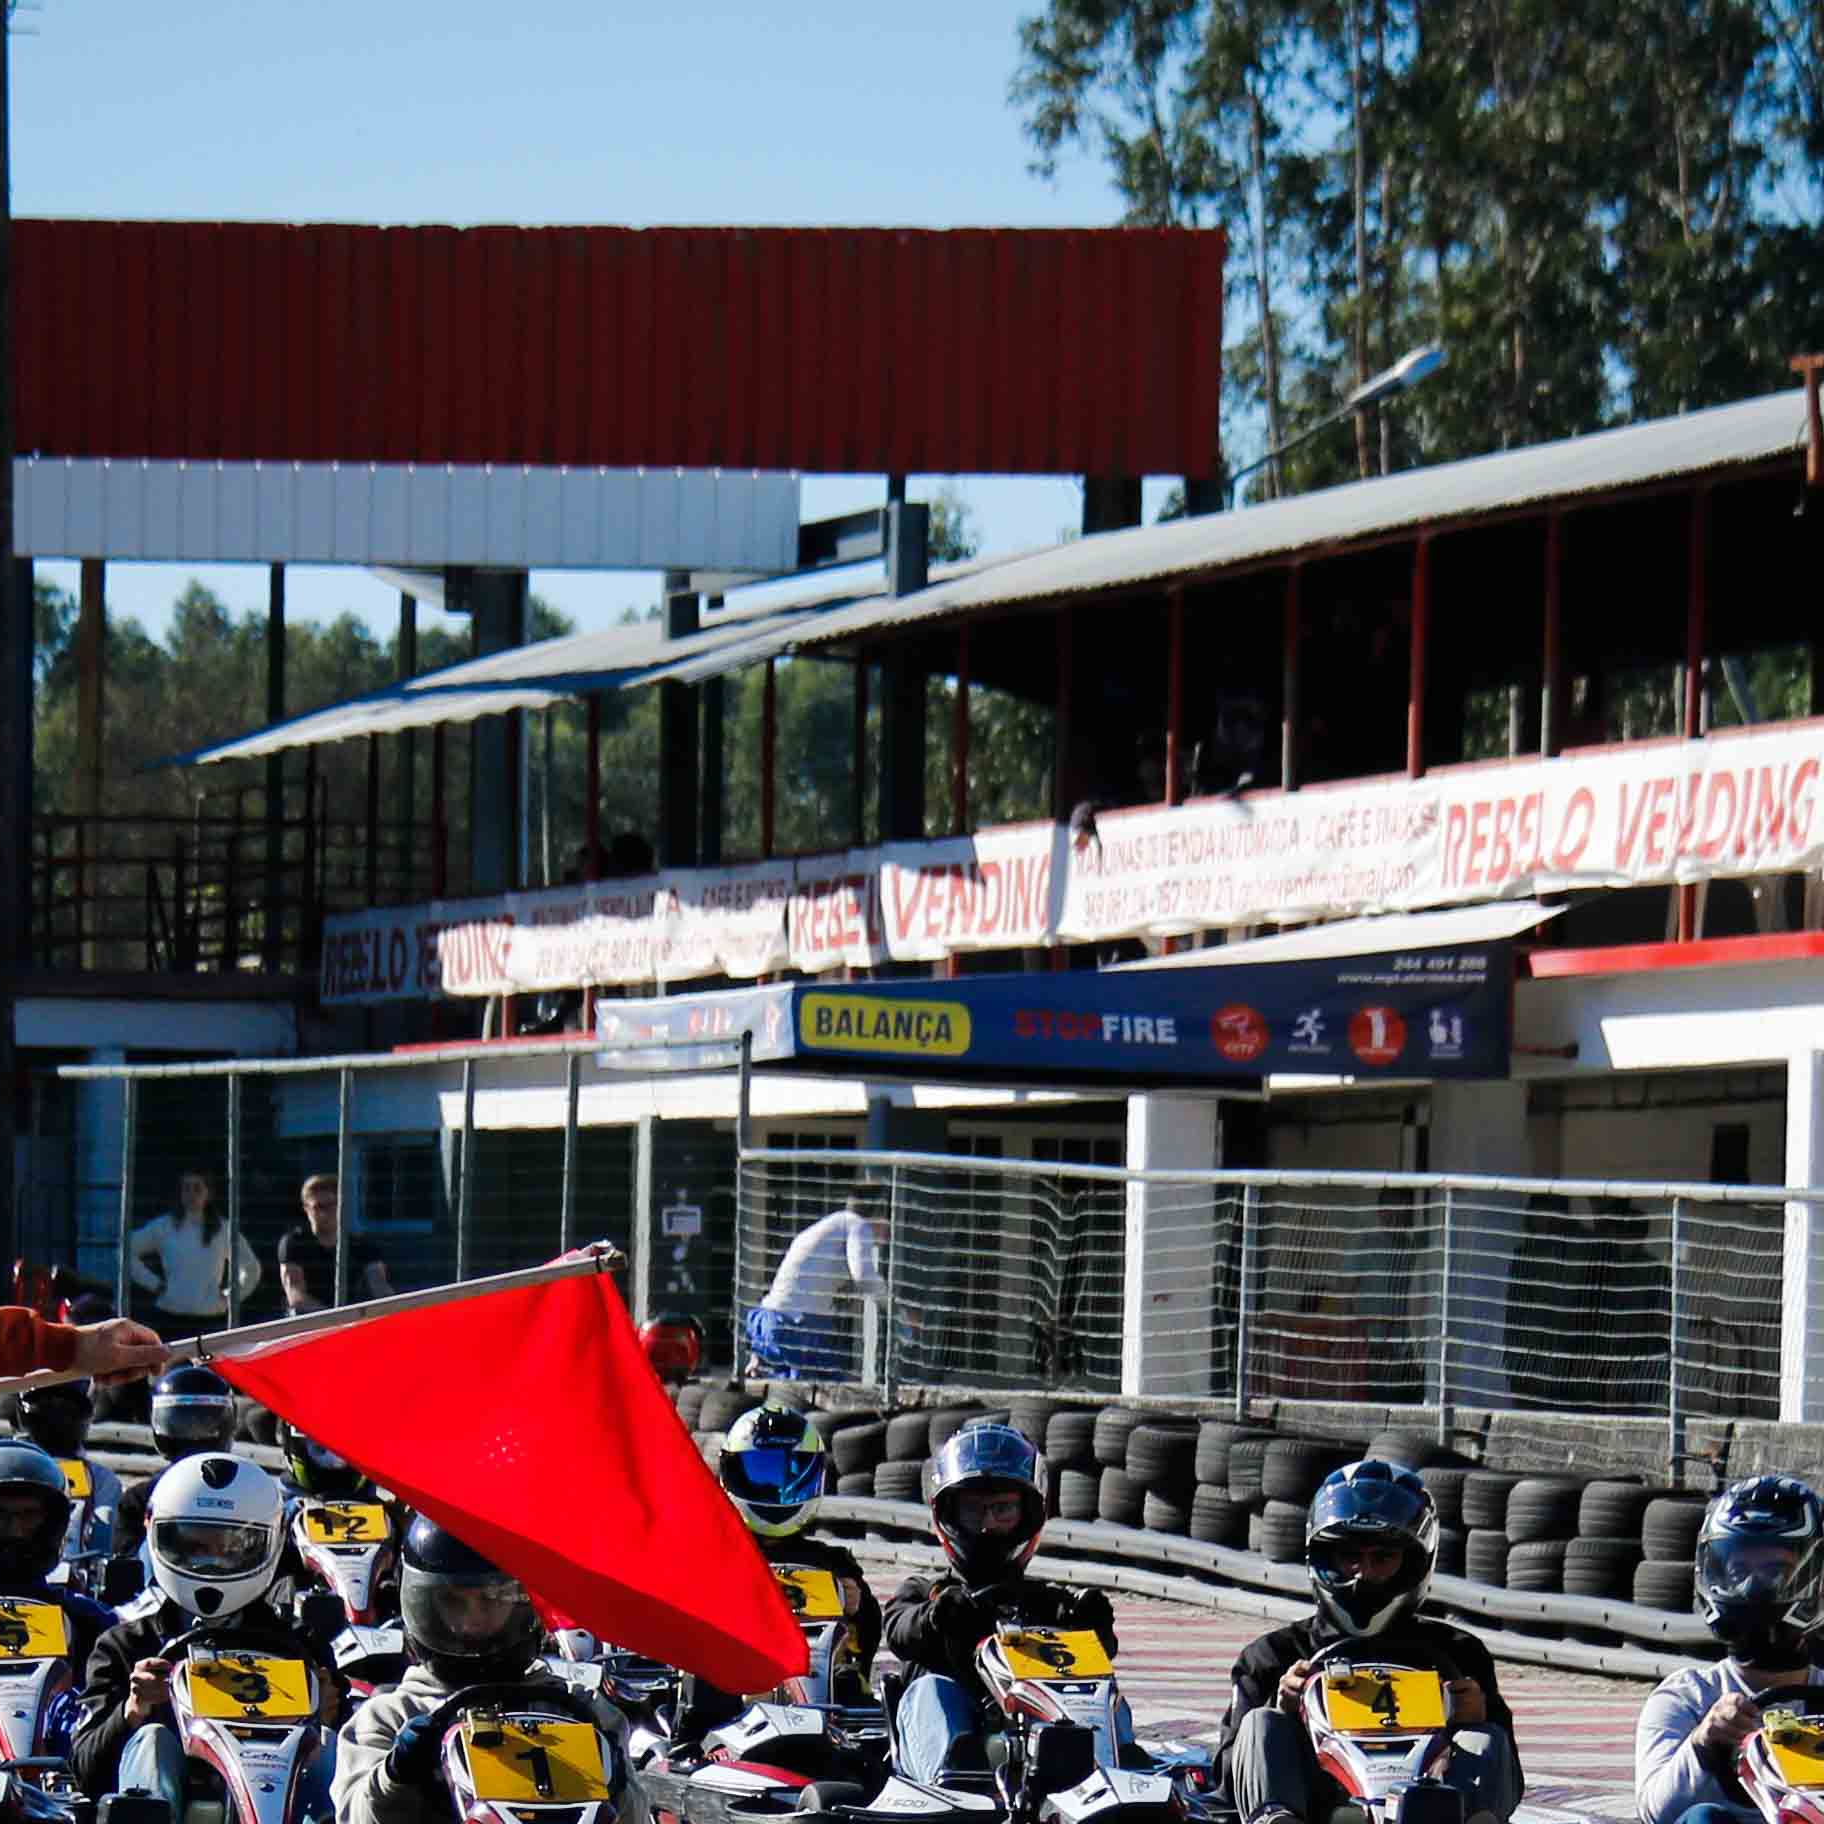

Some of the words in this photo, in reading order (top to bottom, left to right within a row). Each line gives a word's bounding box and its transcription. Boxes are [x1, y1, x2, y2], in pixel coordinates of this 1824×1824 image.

[1616, 759, 1820, 867] VENDING
[816, 996, 953, 1049] BALANÇA
[231, 1672, 270, 1703] 3
[1371, 1678, 1401, 1724] 4
[516, 1745, 554, 1796] 1
